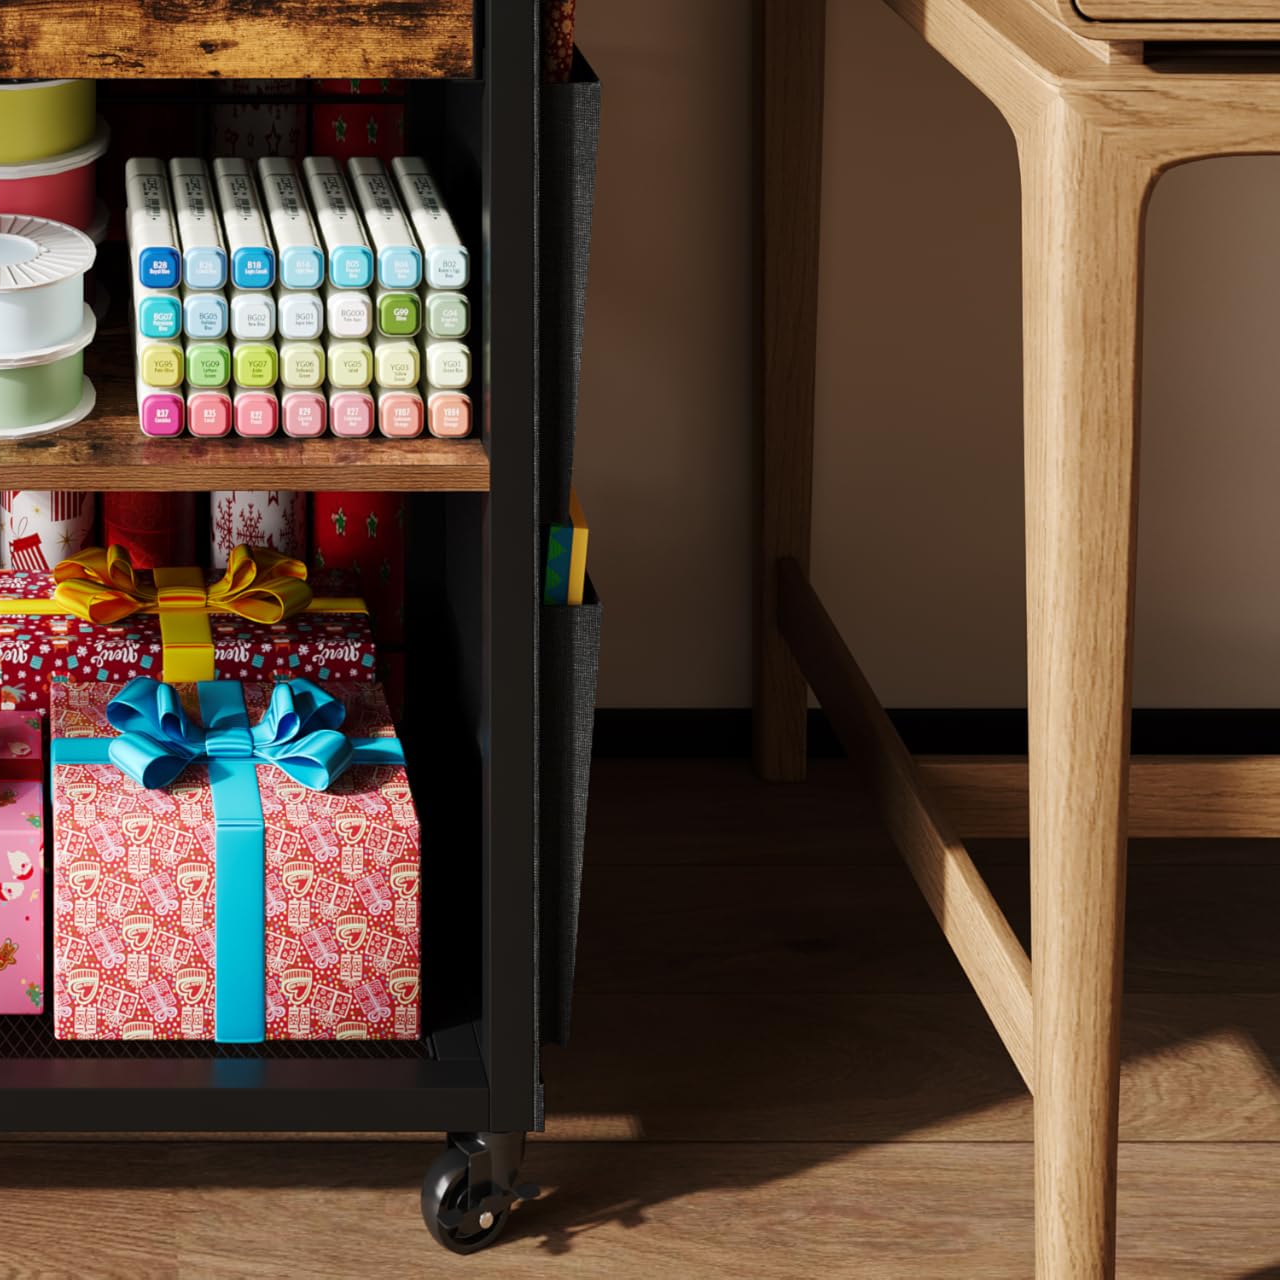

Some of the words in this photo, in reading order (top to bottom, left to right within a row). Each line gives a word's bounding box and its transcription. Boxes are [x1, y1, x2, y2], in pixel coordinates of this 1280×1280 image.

[153, 261, 167, 269] B28
[247, 261, 262, 269] B18
[153, 312, 173, 320] BG07
[393, 308, 409, 316] G99
[200, 360, 220, 368] YG09
[248, 360, 267, 368] YG07
[156, 409, 169, 418] R37
